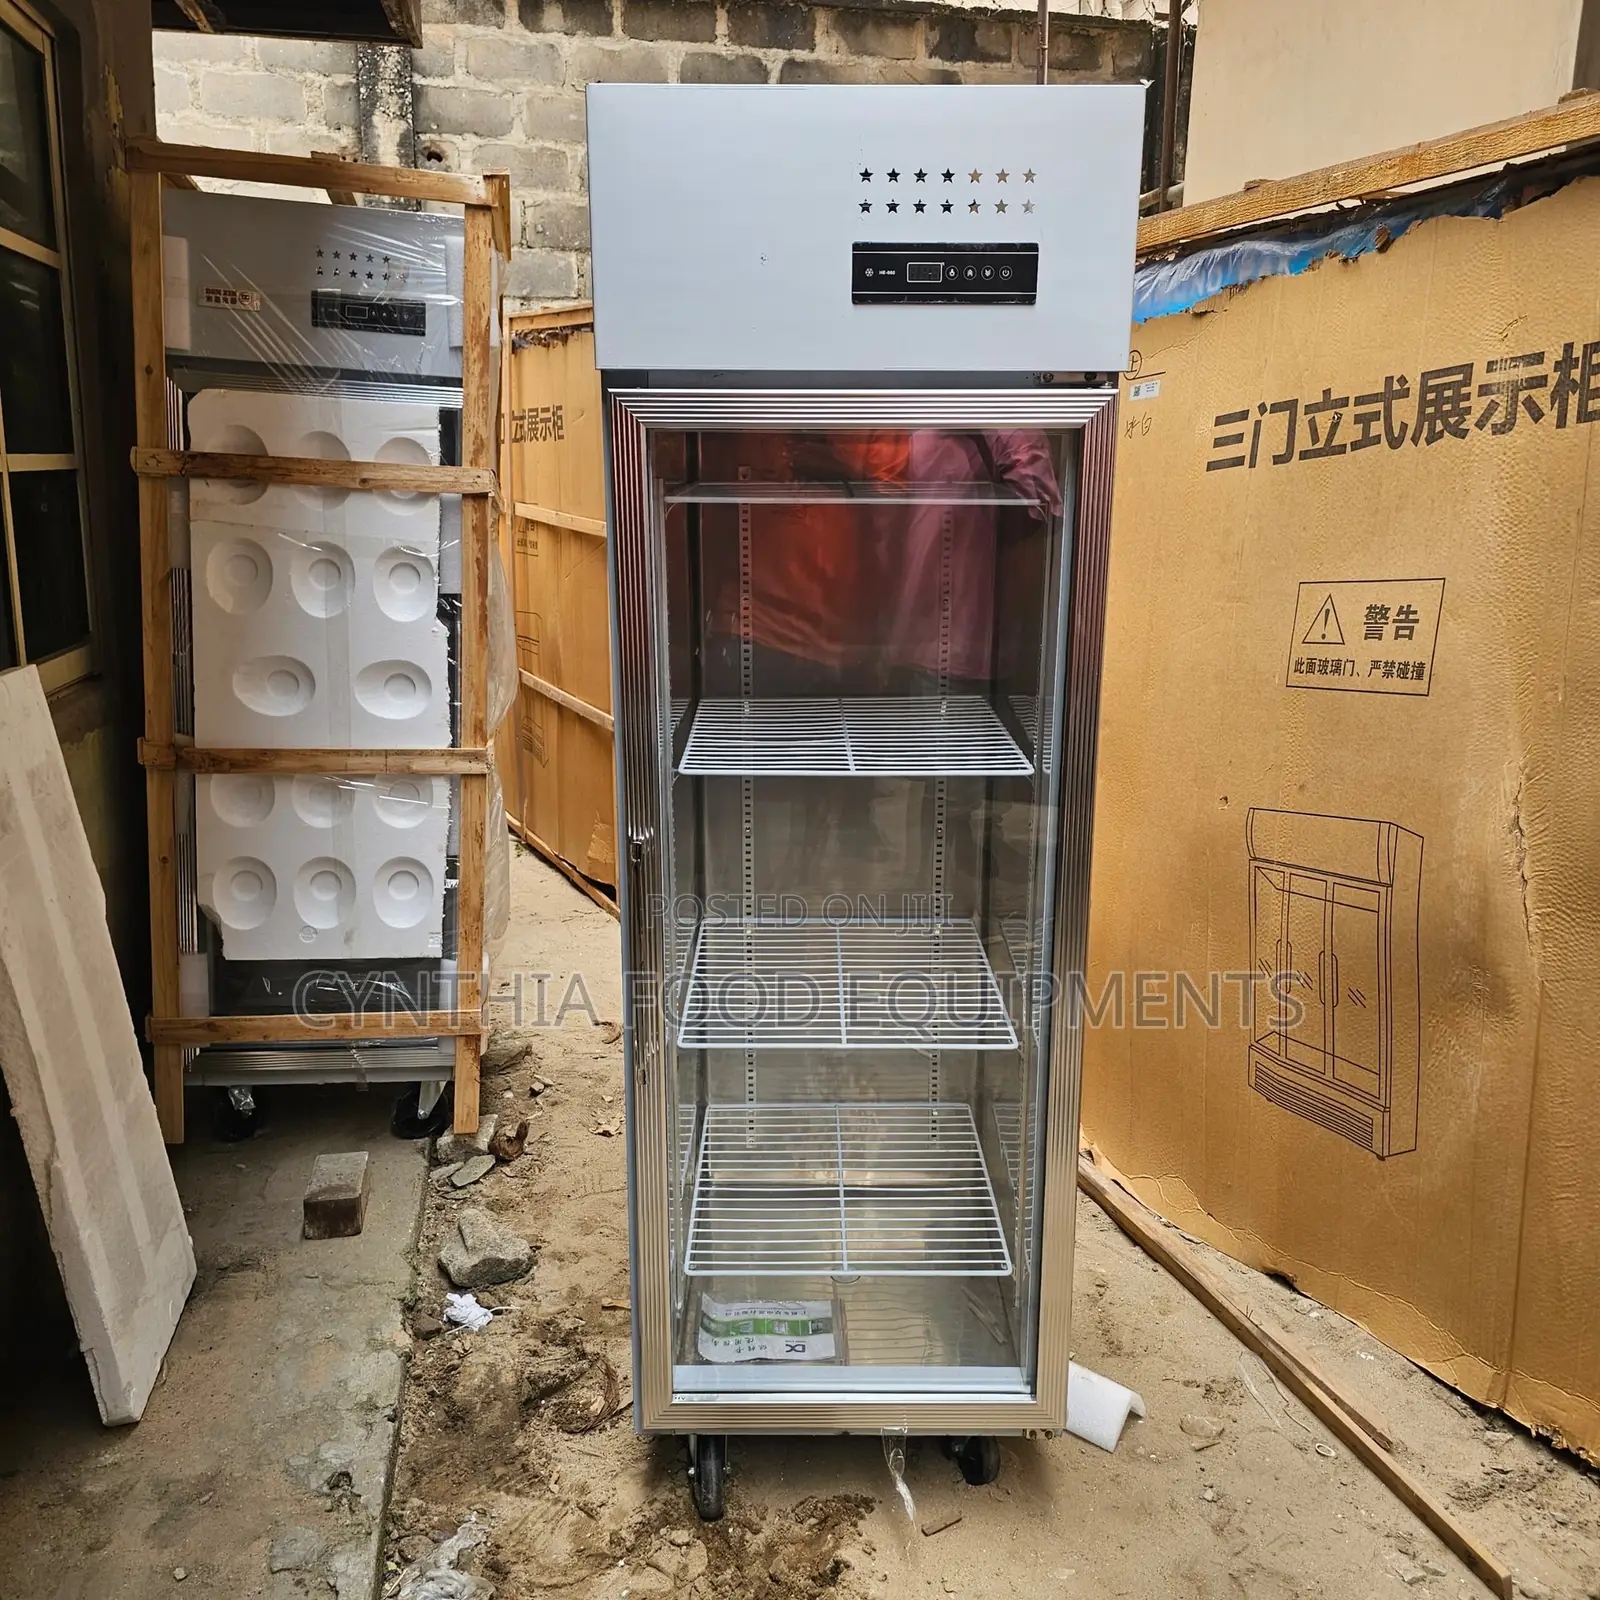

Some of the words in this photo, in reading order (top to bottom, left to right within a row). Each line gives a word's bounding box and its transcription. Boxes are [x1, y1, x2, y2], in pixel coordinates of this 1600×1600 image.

[1206, 341, 1600, 472] 三门立式展示柜
[1363, 603, 1420, 641] 警告
[1293, 656, 1427, 681] 此面玻璃门、严禁碰撞
